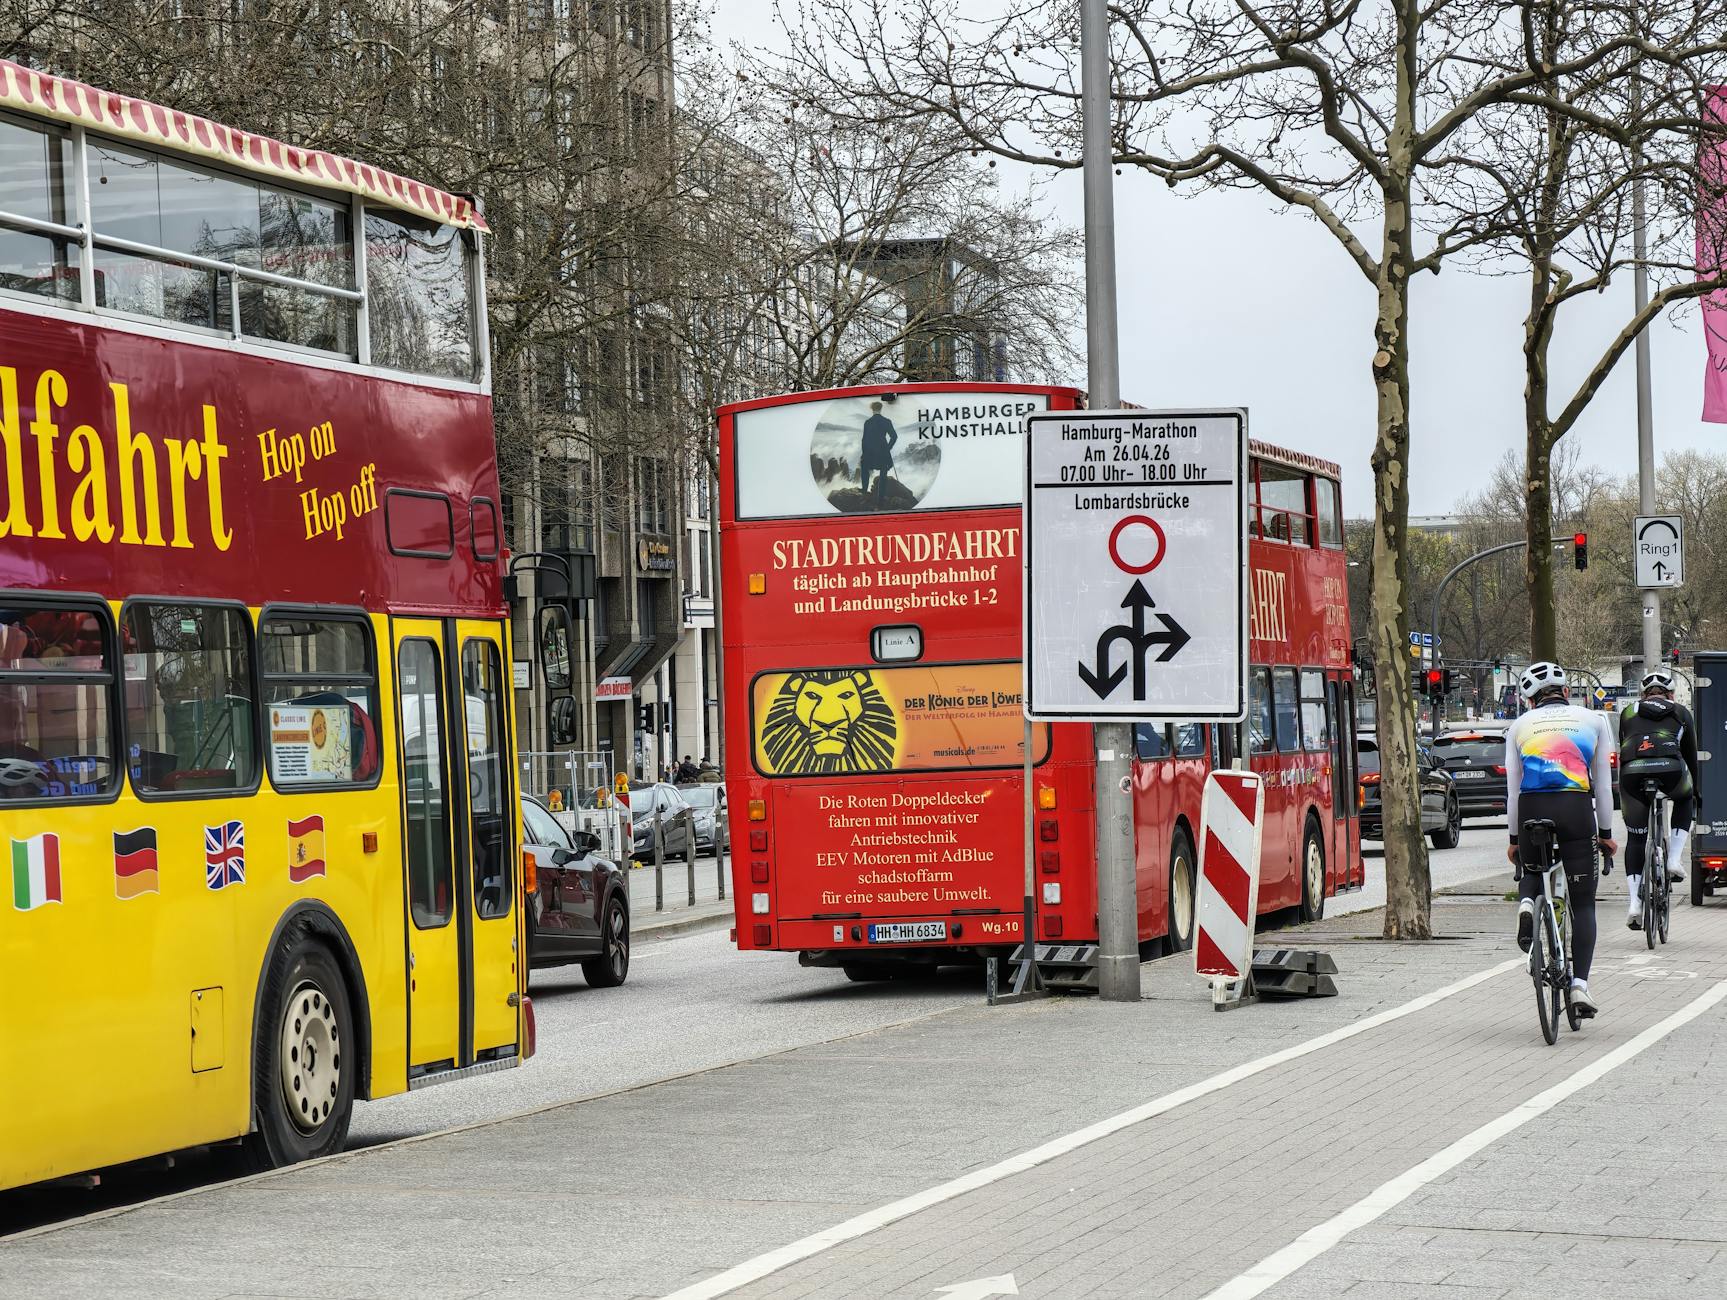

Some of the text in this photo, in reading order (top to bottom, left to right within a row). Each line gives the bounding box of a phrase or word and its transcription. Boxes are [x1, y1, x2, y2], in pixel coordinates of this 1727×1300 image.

[918, 421, 1027, 440] KUNSTHALL
[1062, 423, 1197, 444] Hamburg-Marathon
[257, 420, 338, 483] Hop on
[1084, 445, 1170, 463] Am 26.04.26
[1060, 465, 1096, 482] 07.00
[1141, 464, 1177, 480] 18.00
[1183, 463, 1207, 480] Uhr
[300, 463, 379, 541] Hop off
[1075, 492, 1190, 510] Lombardsbrücke
[773, 527, 1020, 570] STADTRUNDFAHRT
[793, 565, 998, 594] täglich ab Hauptbahnhof
[794, 588, 998, 614] und Landungsbrücke 1-2
[885, 635, 915, 646] Linie A
[904, 691, 1023, 711] DER KÖNIG DER LÖWE
[905, 713, 922, 721] DER
[924, 713, 976, 721] WELTERFOLG
[988, 710, 1024, 718] HAMBU
[933, 746, 976, 757] musicals.de
[819, 791, 986, 811] Die Roten Doppeldecker
[829, 811, 979, 828] fahren mit innovativer
[850, 830, 958, 847] Antriebstechnik
[816, 848, 994, 867] EEV Motoren mit AdBlue
[858, 869, 954, 884] schadstoffarm
[821, 886, 992, 906] für eine saubere Umwelt.
[876, 924, 944, 939] HH HH 6834
[981, 921, 1019, 935] Wg.10
